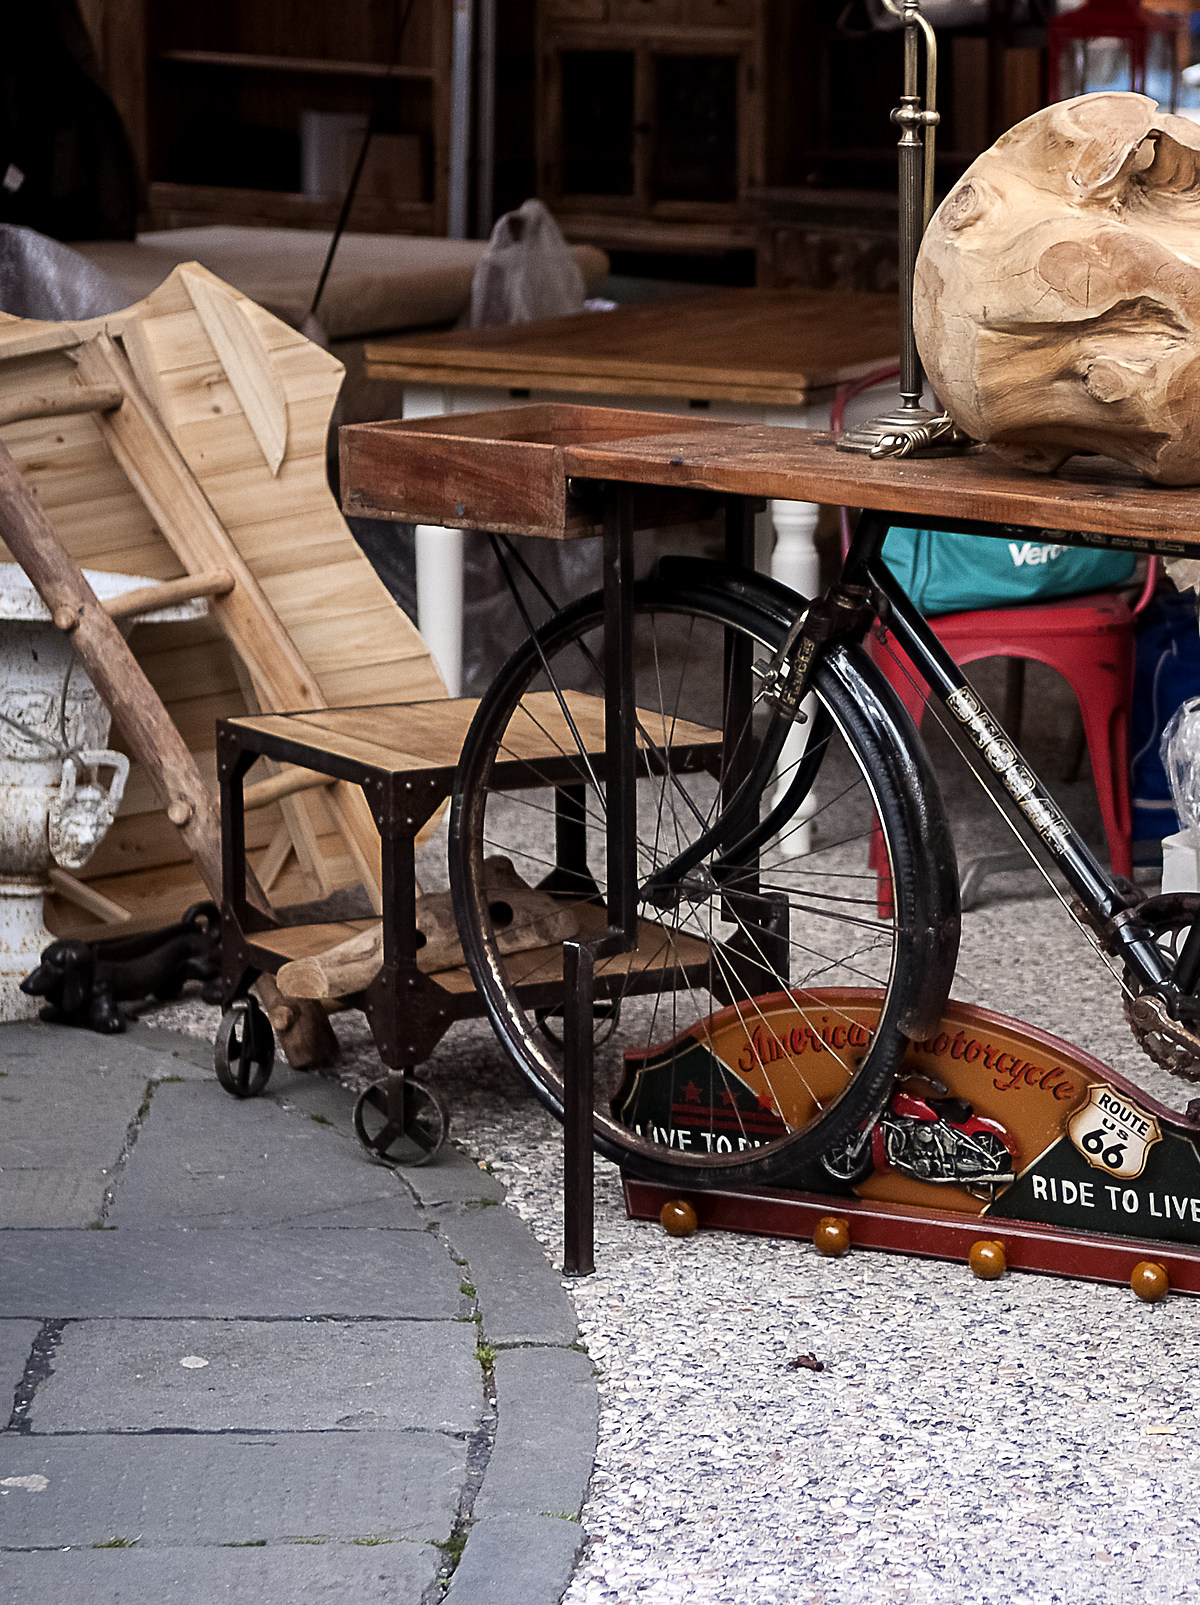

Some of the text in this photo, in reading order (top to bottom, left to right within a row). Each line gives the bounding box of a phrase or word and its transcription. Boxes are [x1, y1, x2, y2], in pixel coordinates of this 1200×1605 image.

[912, 1030, 1076, 1101] otorcycle
[1098, 1092, 1151, 1137] ROUTE
[1081, 1128, 1129, 1169] 66
[1031, 1174, 1096, 1208] RIDE
[1104, 1185, 1140, 1214] TO
